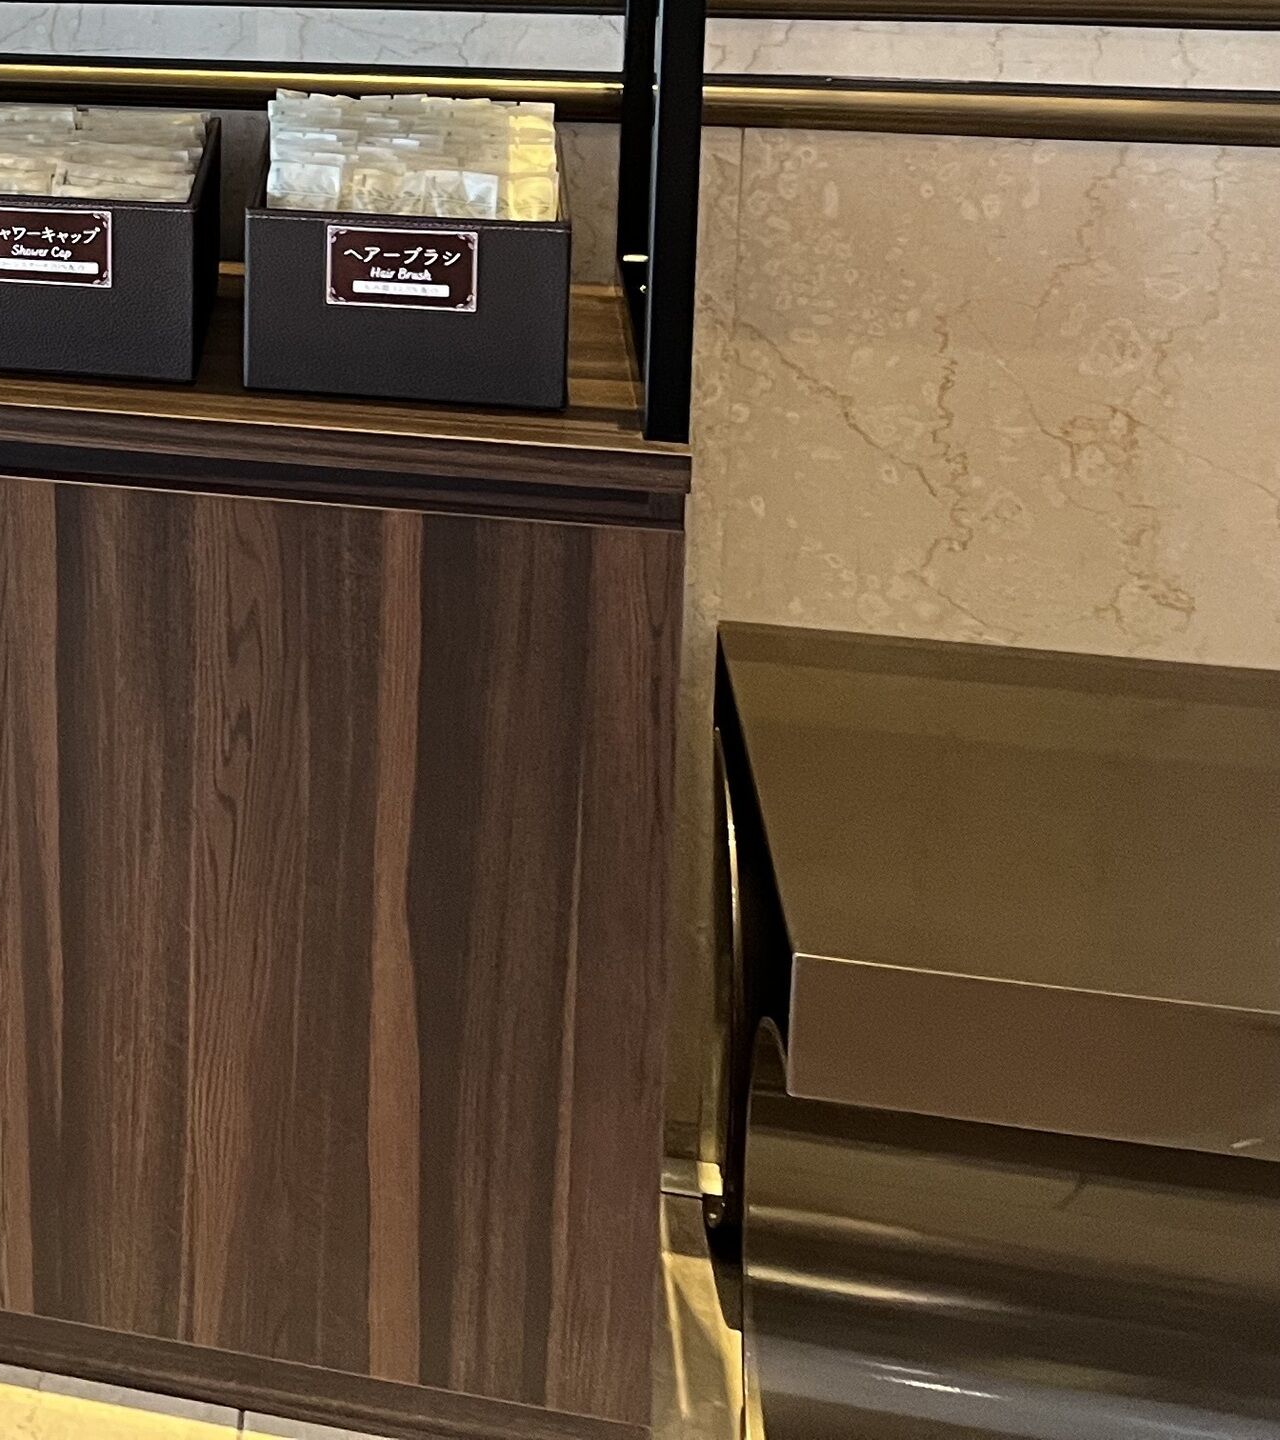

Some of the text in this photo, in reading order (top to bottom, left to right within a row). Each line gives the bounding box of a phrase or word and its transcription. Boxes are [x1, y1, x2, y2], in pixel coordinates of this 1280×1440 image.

[11, 244, 72, 260] Shower Cap
[343, 246, 461, 266] ヘアーブラシ
[370, 266, 432, 281] Hair Brush
